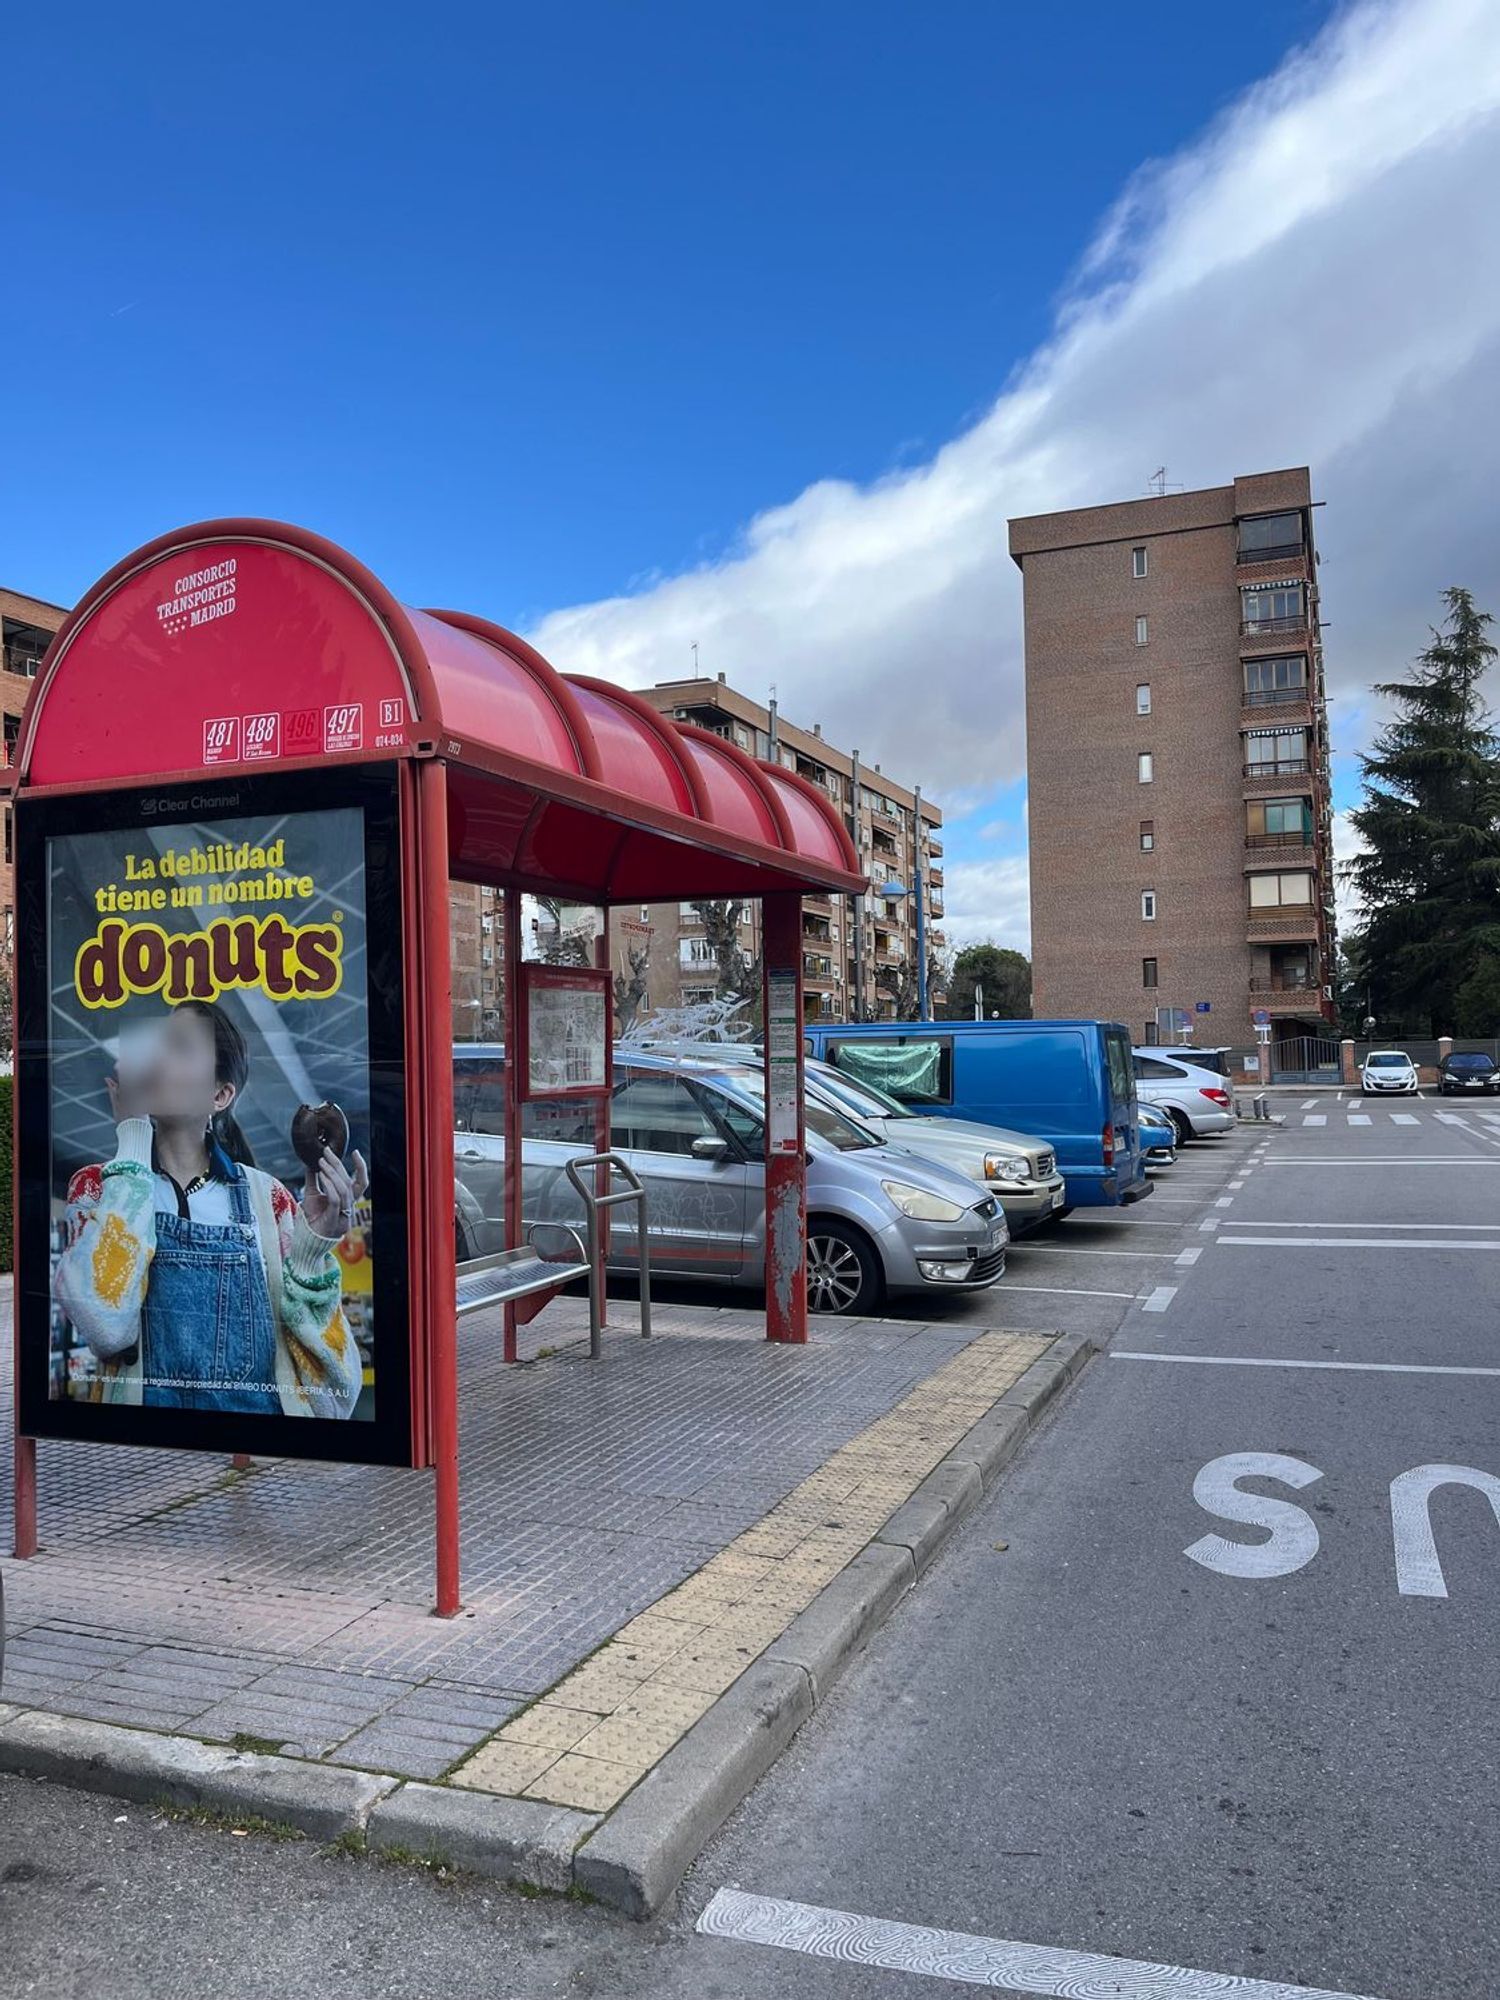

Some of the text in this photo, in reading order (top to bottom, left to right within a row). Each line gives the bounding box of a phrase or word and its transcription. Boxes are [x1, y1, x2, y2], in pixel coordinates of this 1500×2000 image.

[175, 558, 237, 595] CONSORCIO
[157, 577, 236, 620] TRANSPORTES
[190, 597, 236, 628] MADRID
[286, 712, 316, 739] 496
[327, 707, 359, 735] 497
[384, 703, 399, 723] B1
[207, 720, 234, 747] 481
[246, 716, 275, 743] 488
[158, 792, 240, 812] Clear Channel
[125, 839, 285, 881] La debilidad
[95, 872, 314, 912] tiene un nombre
[77, 917, 340, 1006] donuts
[149, 1377, 184, 1388] registrada
[185, 1379, 221, 1390] propiedad
[234, 1381, 260, 1392] BIMBO
[261, 1382, 295, 1394] DONUTS
